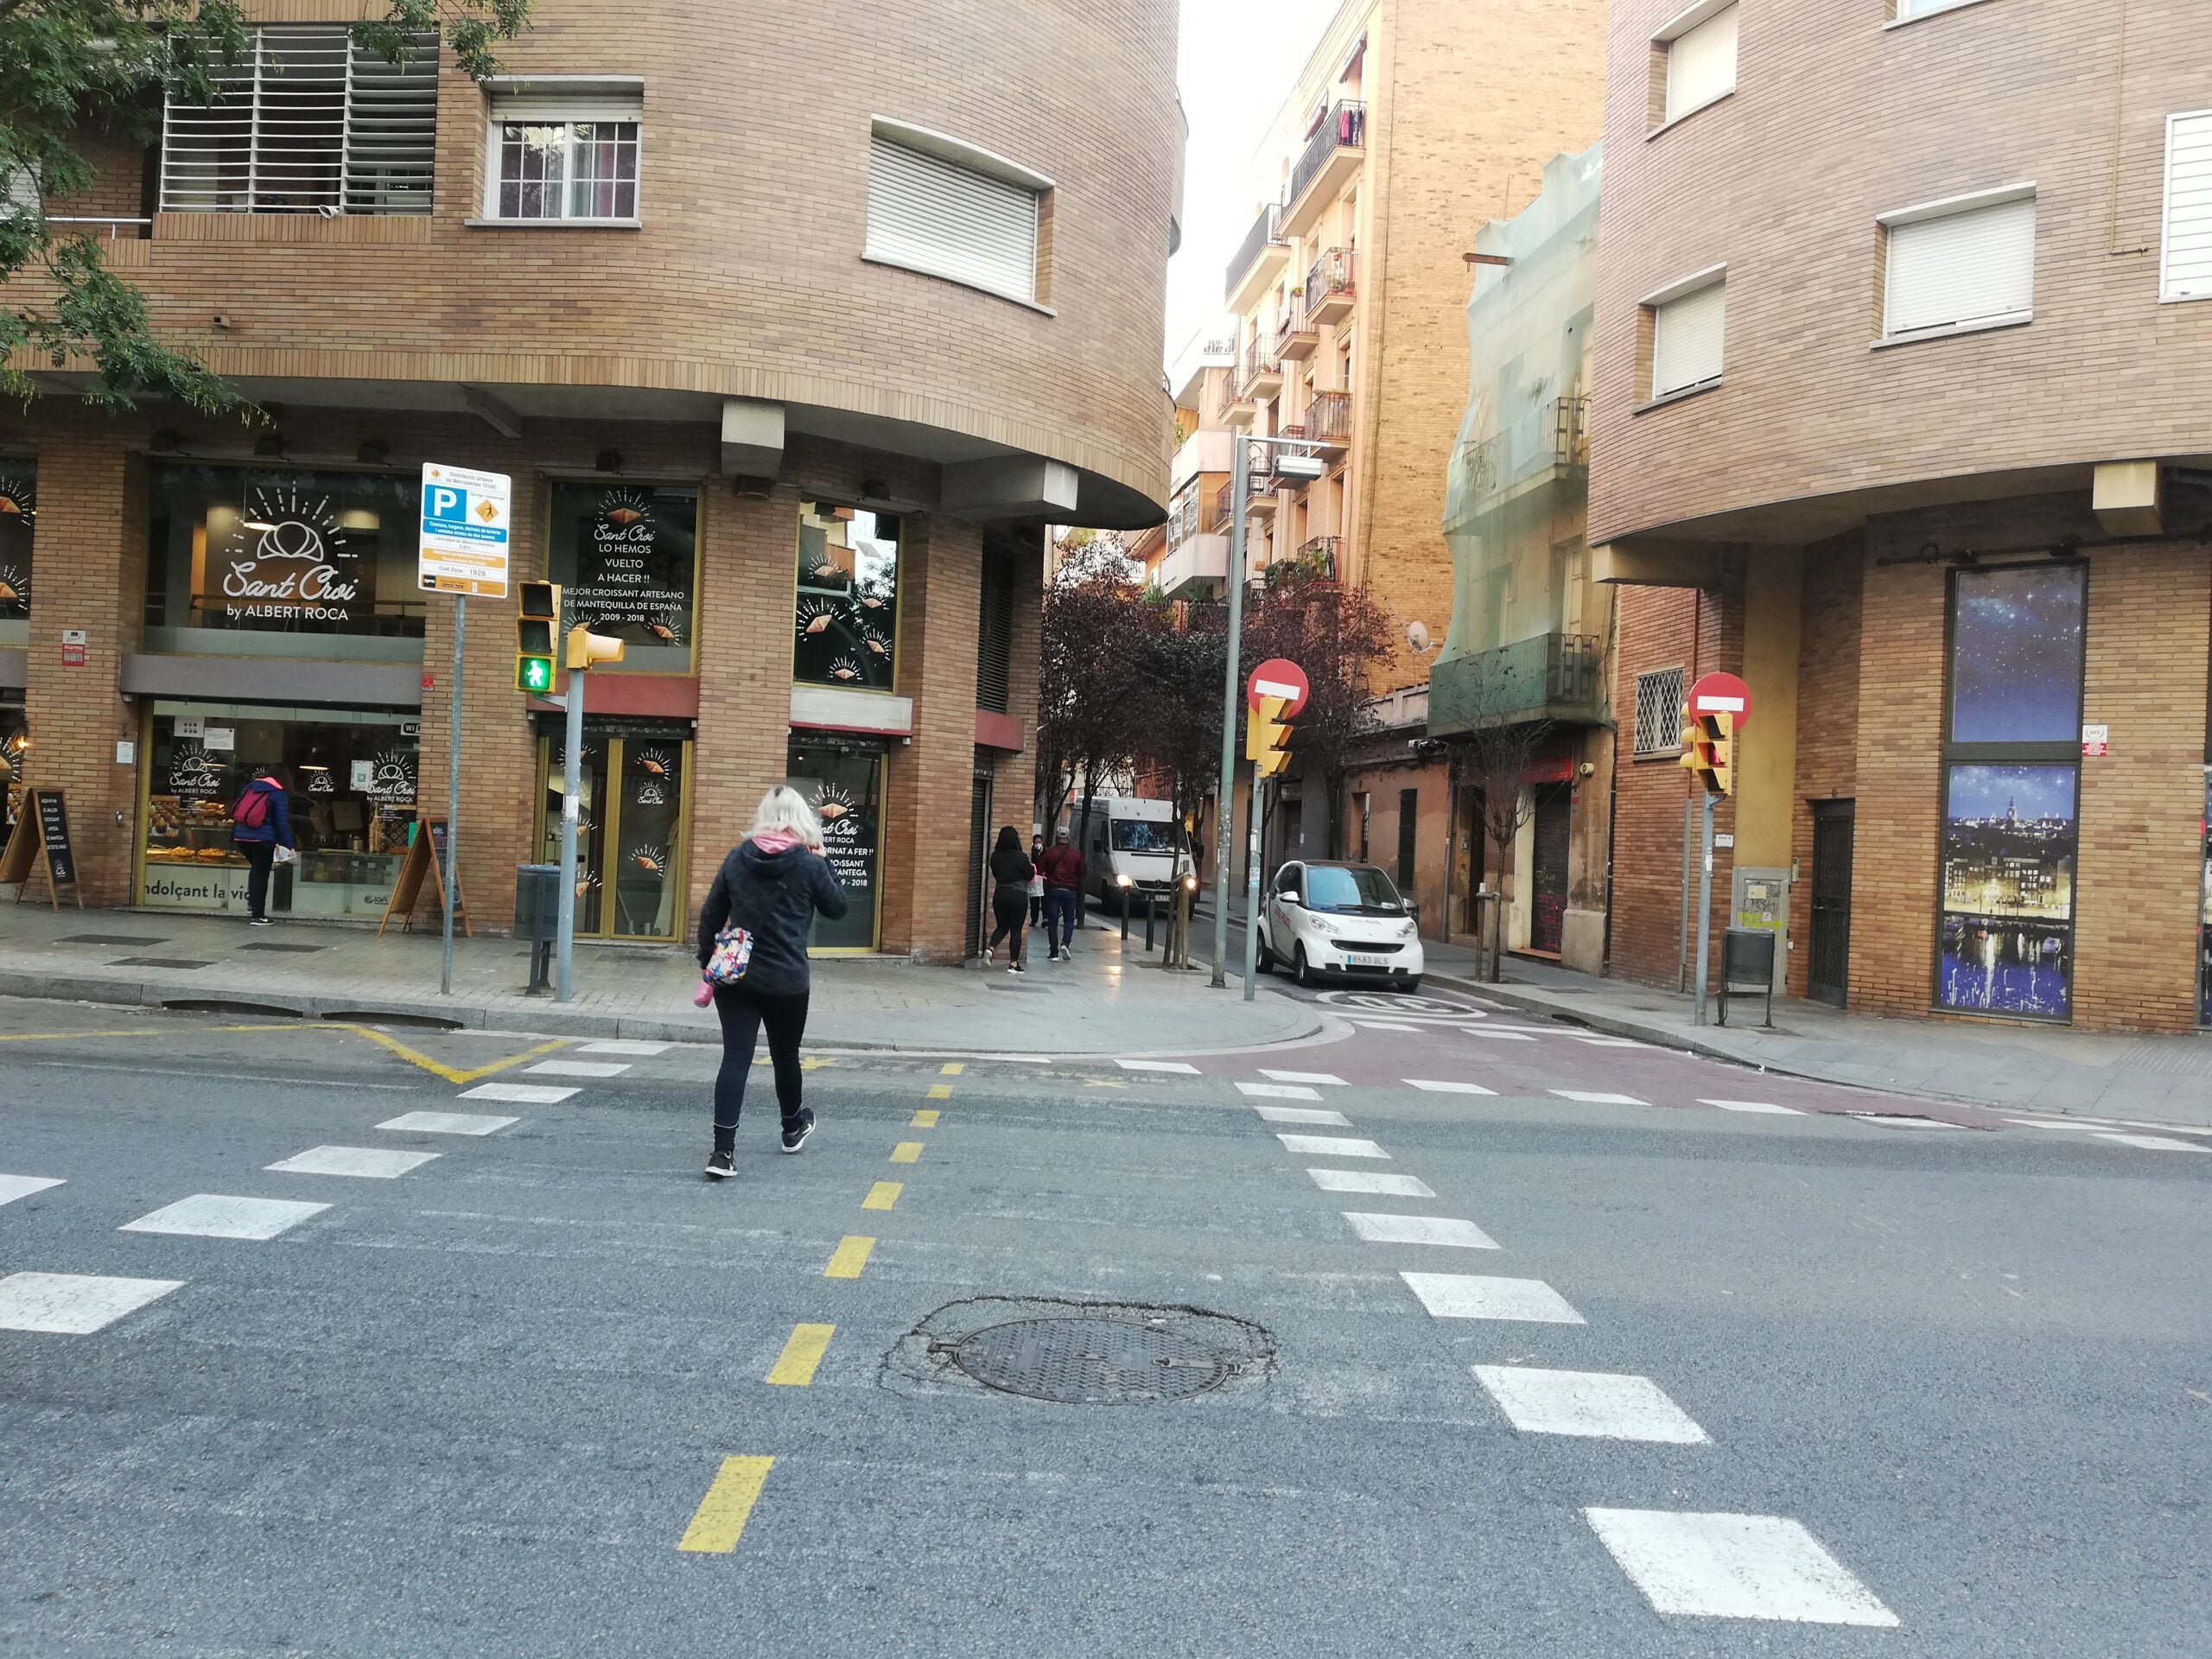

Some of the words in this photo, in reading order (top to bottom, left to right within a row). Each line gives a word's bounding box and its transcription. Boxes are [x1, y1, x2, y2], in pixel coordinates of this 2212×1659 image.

[434, 488, 457, 517] P
[594, 524, 627, 540] Sant
[628, 525, 655, 541] Croi
[599, 543, 612, 552] LO
[615, 544, 651, 554] HEMOS
[605, 559, 643, 568] VUELTO
[223, 561, 296, 598] Sant
[299, 565, 359, 601] Croi
[597, 573, 605, 582] A
[607, 574, 641, 583] HACER
[562, 587, 591, 596] MEJOR
[593, 588, 639, 597] CROISSANT
[640, 590, 684, 599] ARTESANO
[226, 604, 242, 620] by
[245, 605, 301, 618] ALBERT
[305, 607, 349, 621] ROCA
[577, 601, 635, 610] MANTEQUILLA
[650, 602, 682, 611] ESPAÑA
[170, 772, 197, 786] Sant
[198, 773, 221, 787] Croi
[366, 780, 393, 794] Sant
[394, 781, 416, 795] Croi
[835, 819, 858, 835] Croi
[213, 883, 225, 898] la
